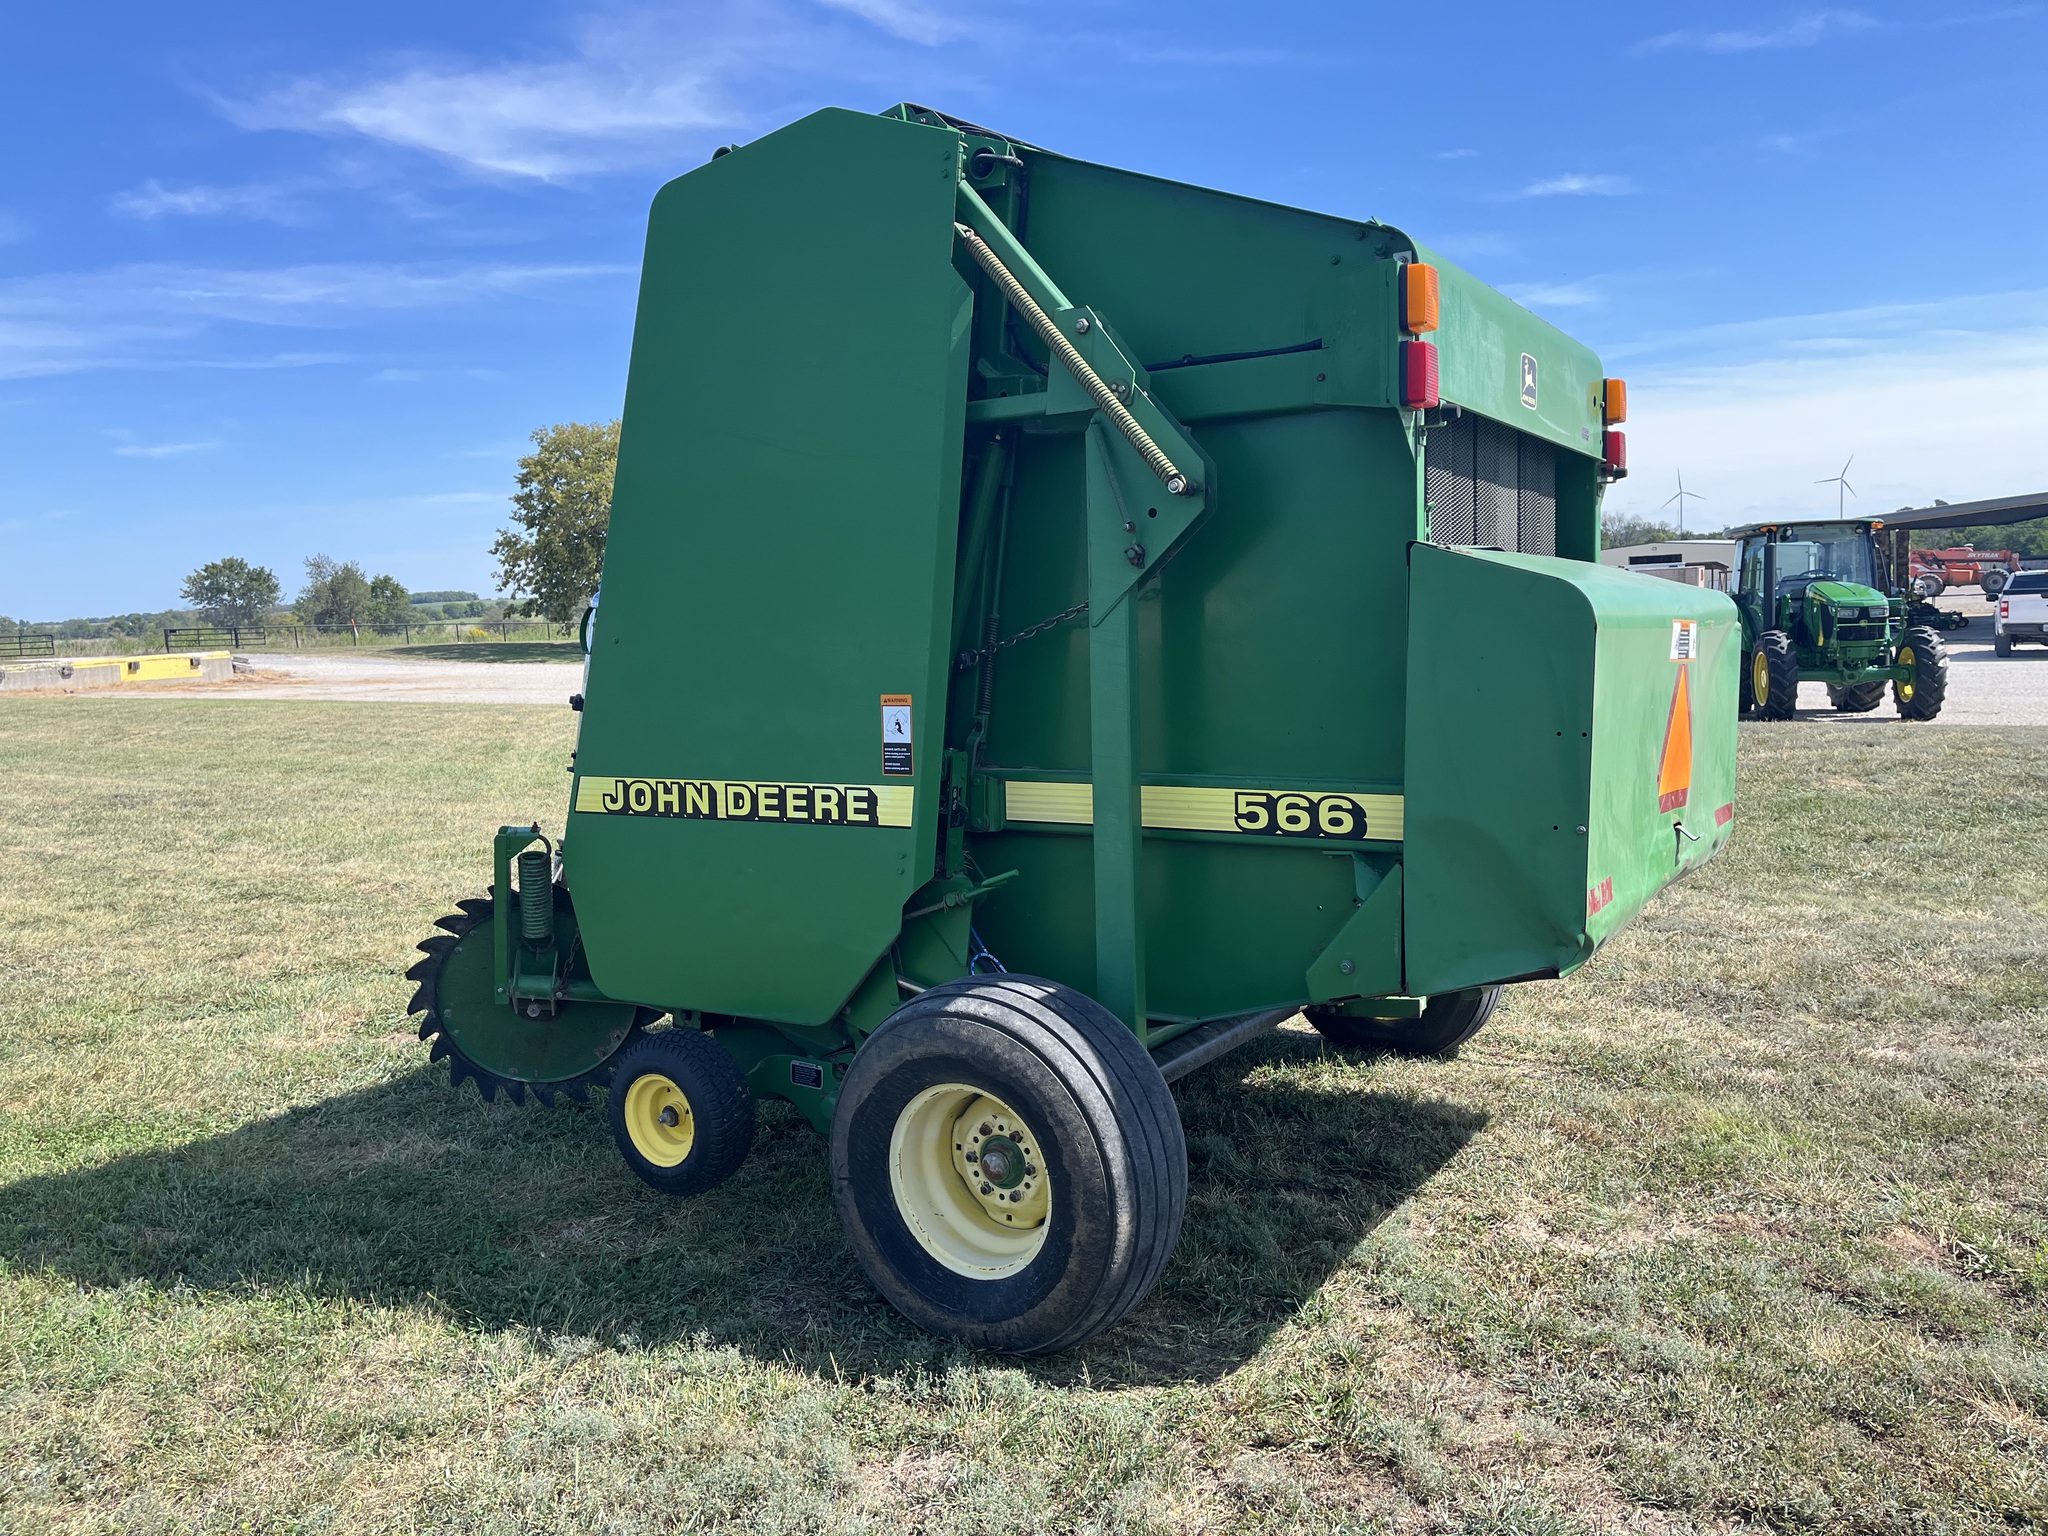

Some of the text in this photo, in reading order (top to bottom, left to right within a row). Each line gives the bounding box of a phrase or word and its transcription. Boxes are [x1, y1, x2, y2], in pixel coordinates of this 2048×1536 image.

[602, 780, 872, 823] JOHN DEERE
[1235, 792, 1358, 837] 566
